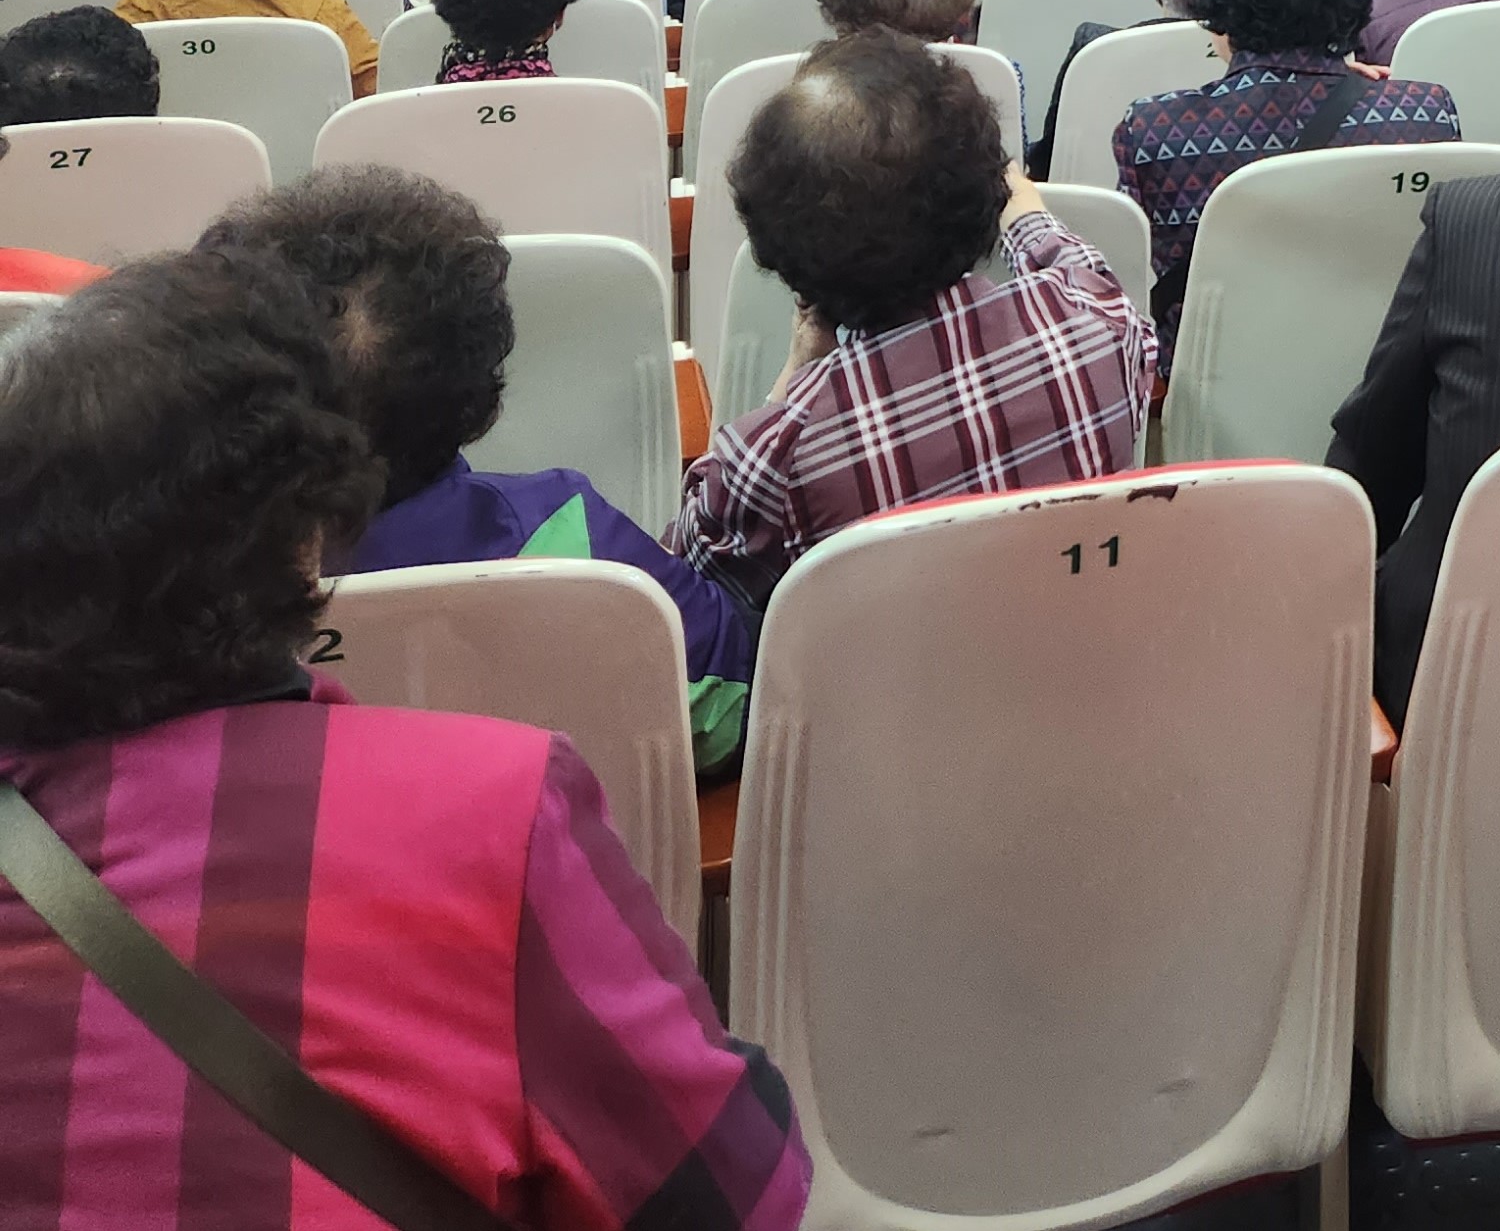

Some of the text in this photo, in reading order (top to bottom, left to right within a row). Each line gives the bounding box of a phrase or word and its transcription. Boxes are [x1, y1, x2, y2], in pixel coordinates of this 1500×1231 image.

[182, 39, 216, 55] 30
[477, 105, 516, 124] 26
[50, 148, 92, 168] 27
[1391, 172, 1430, 193] 19
[1061, 535, 1119, 574] 11
[308, 628, 344, 664] 2
